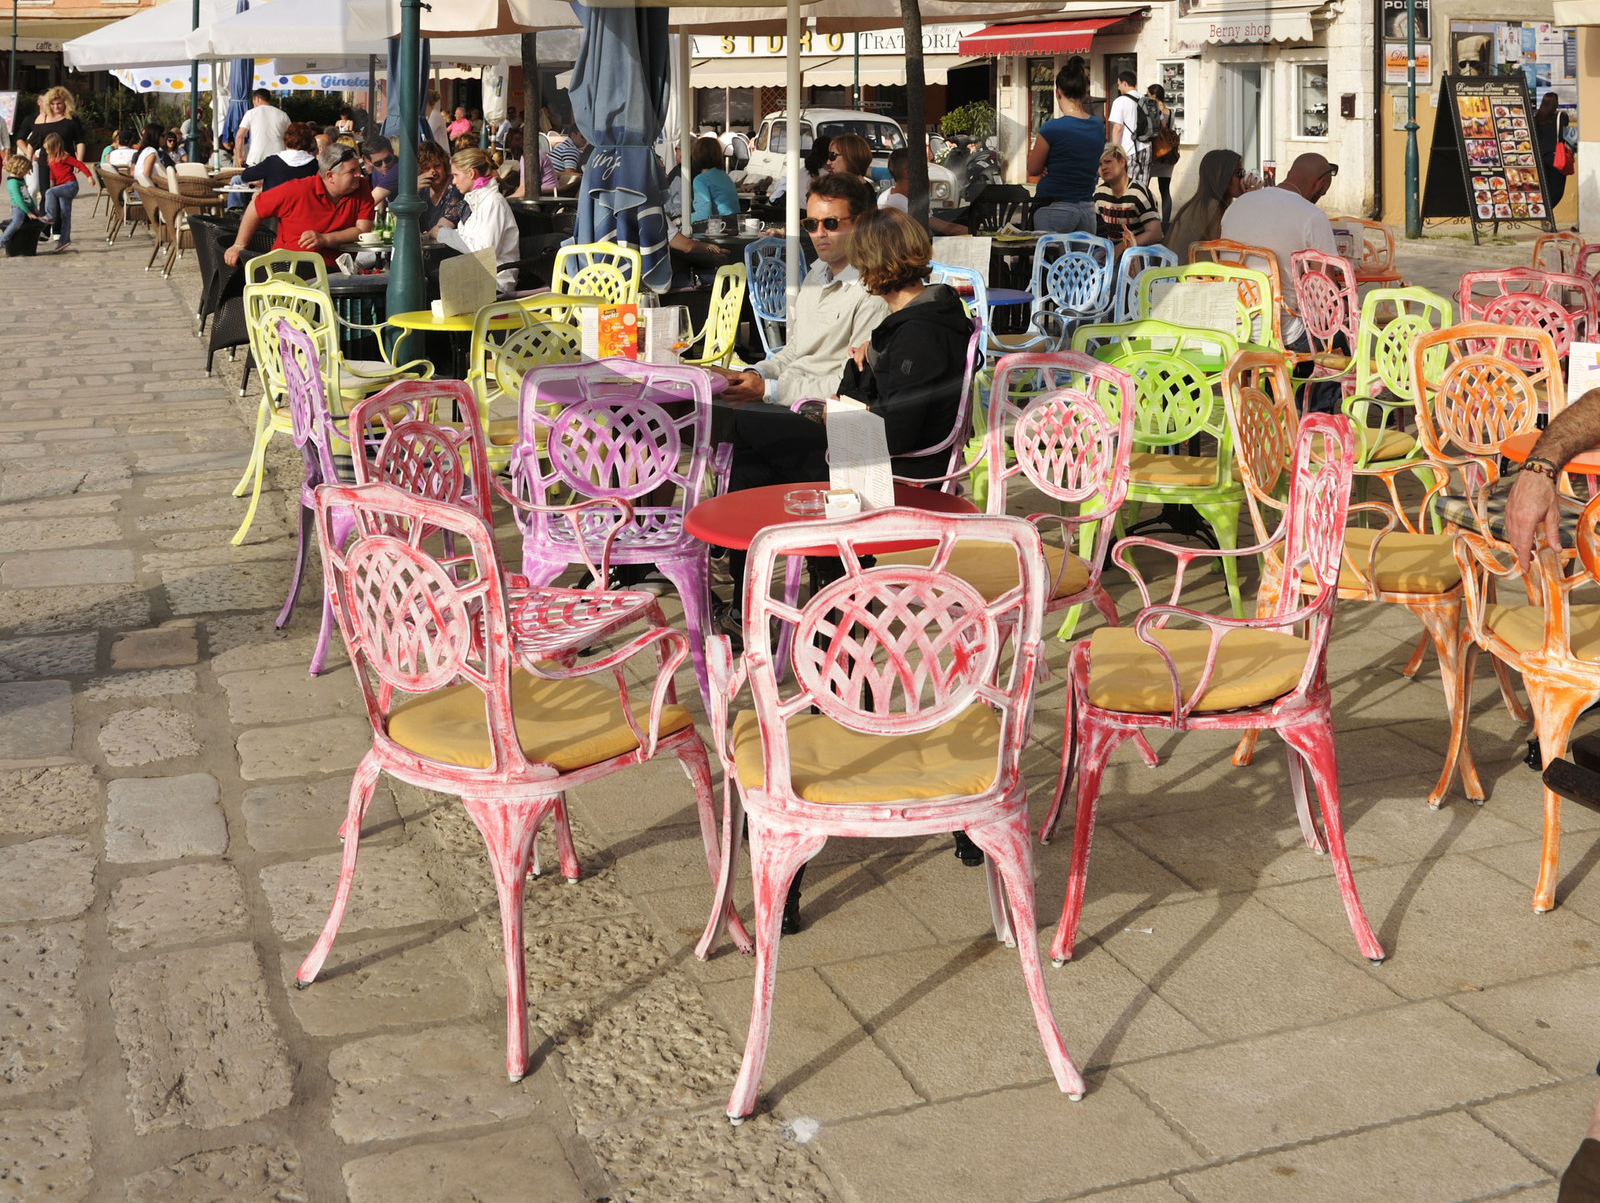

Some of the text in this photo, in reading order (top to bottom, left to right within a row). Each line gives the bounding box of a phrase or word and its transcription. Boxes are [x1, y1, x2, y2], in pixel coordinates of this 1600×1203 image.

[1384, 0, 1428, 9] POLCE
[1209, 22, 1271, 39] Berny shop
[860, 30, 964, 49] TRATORIA
